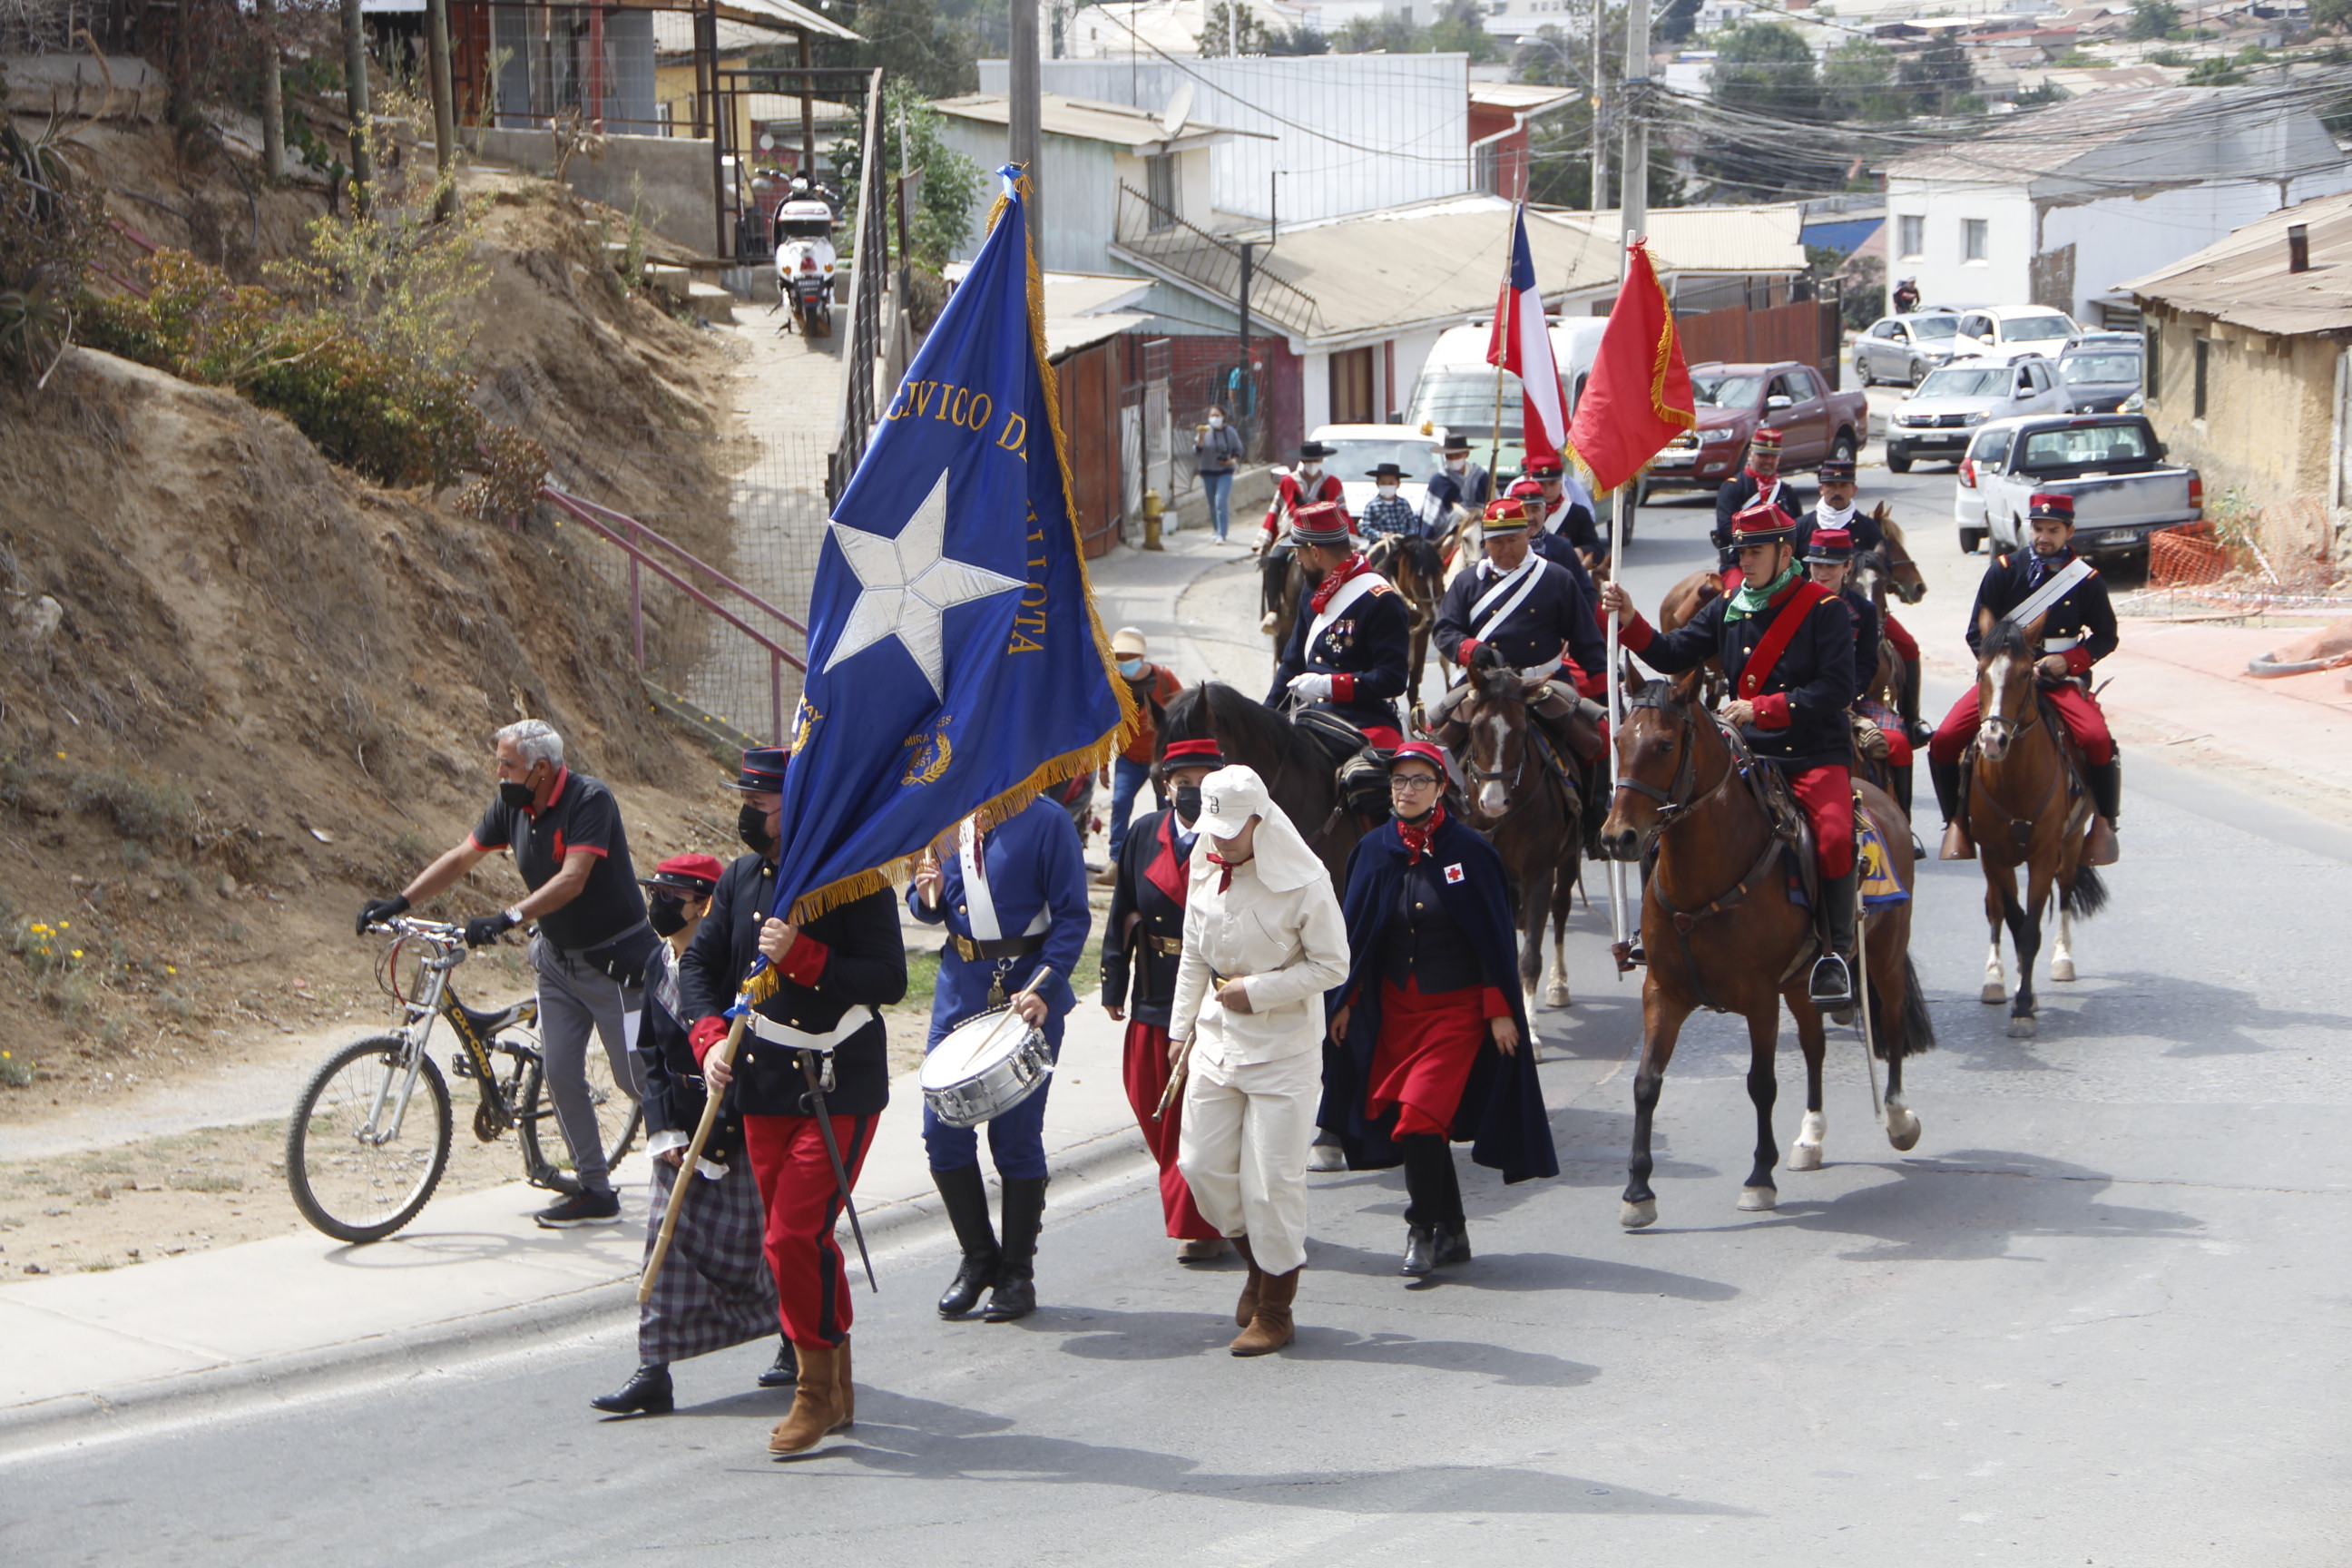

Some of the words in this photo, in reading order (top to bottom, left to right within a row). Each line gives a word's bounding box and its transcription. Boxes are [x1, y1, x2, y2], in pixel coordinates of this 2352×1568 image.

[885, 379, 993, 431] CIVICO
[996, 411, 1028, 463] D
[1210, 795, 1220, 815] B
[451, 1007, 493, 1078] OXFORD
